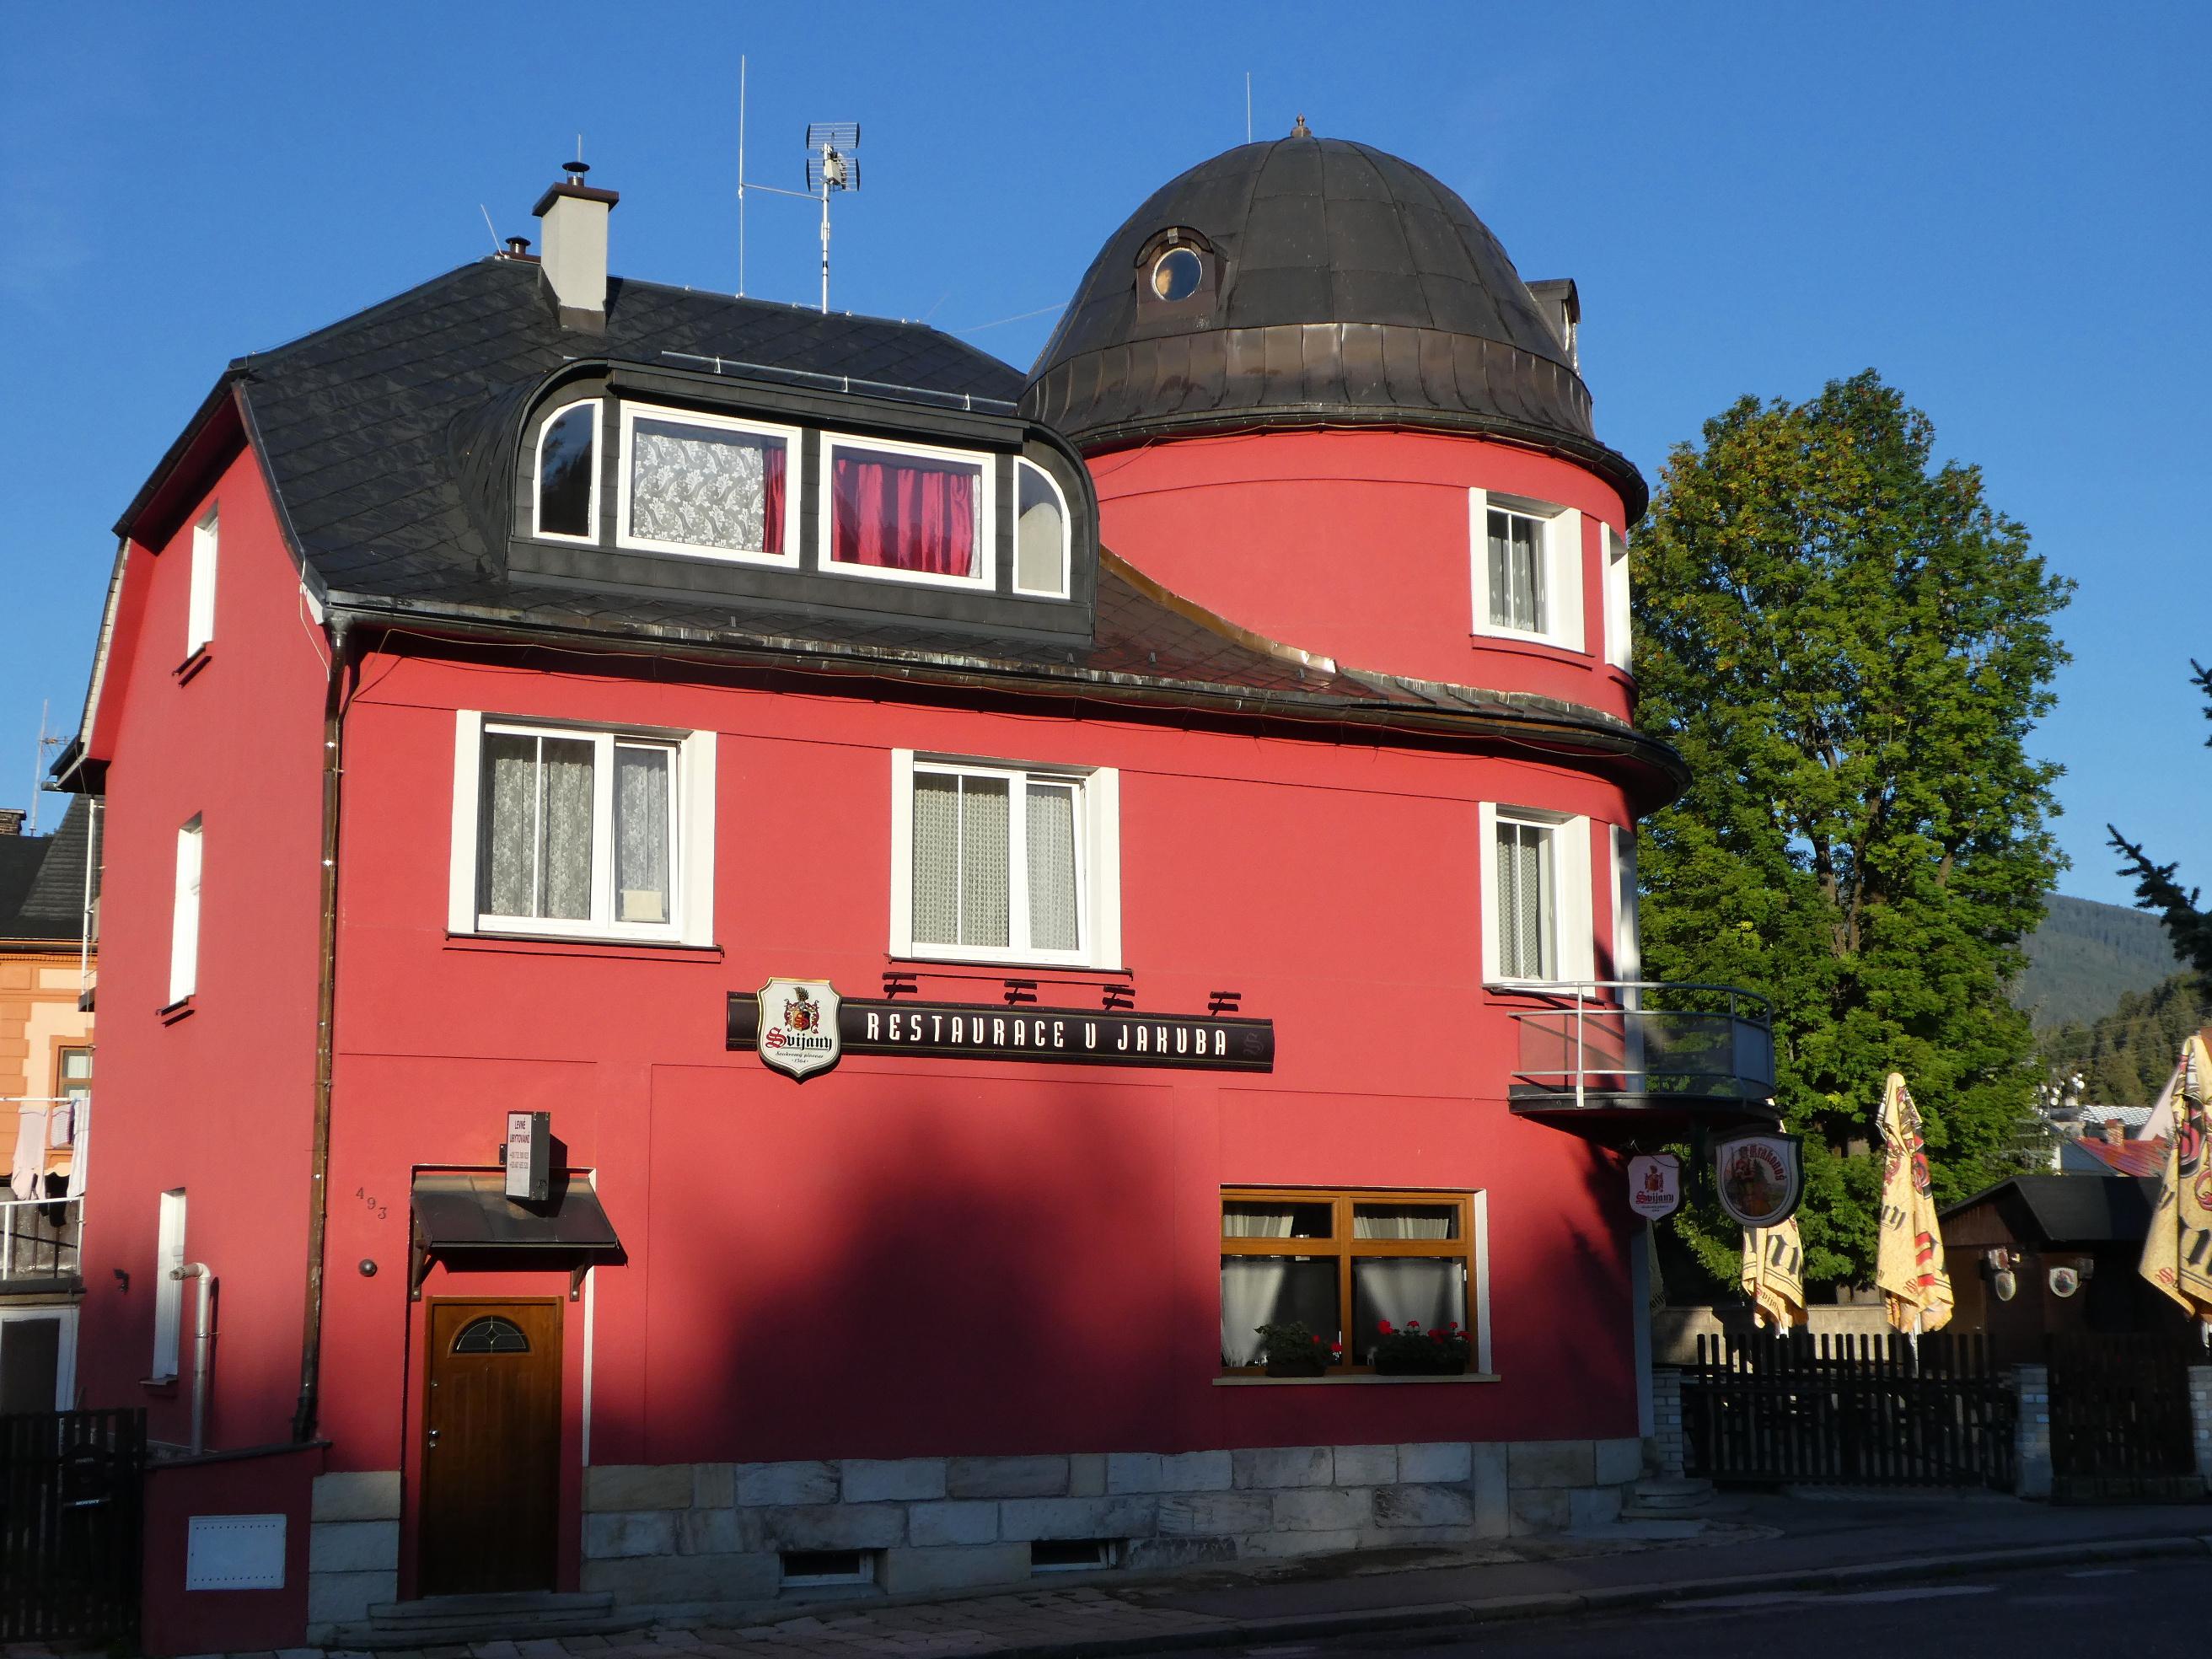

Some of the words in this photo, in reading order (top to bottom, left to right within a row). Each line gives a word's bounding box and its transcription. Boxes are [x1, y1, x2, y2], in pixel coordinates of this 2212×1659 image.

[765, 1027, 832, 1051] Svijany
[867, 1012, 1065, 1048] RESTAURACE
[1085, 1023, 1096, 1049] U
[1117, 1024, 1227, 1055] JAKUBA
[356, 1186, 387, 1220] 493
[1635, 1190, 1674, 1205] Svijany
